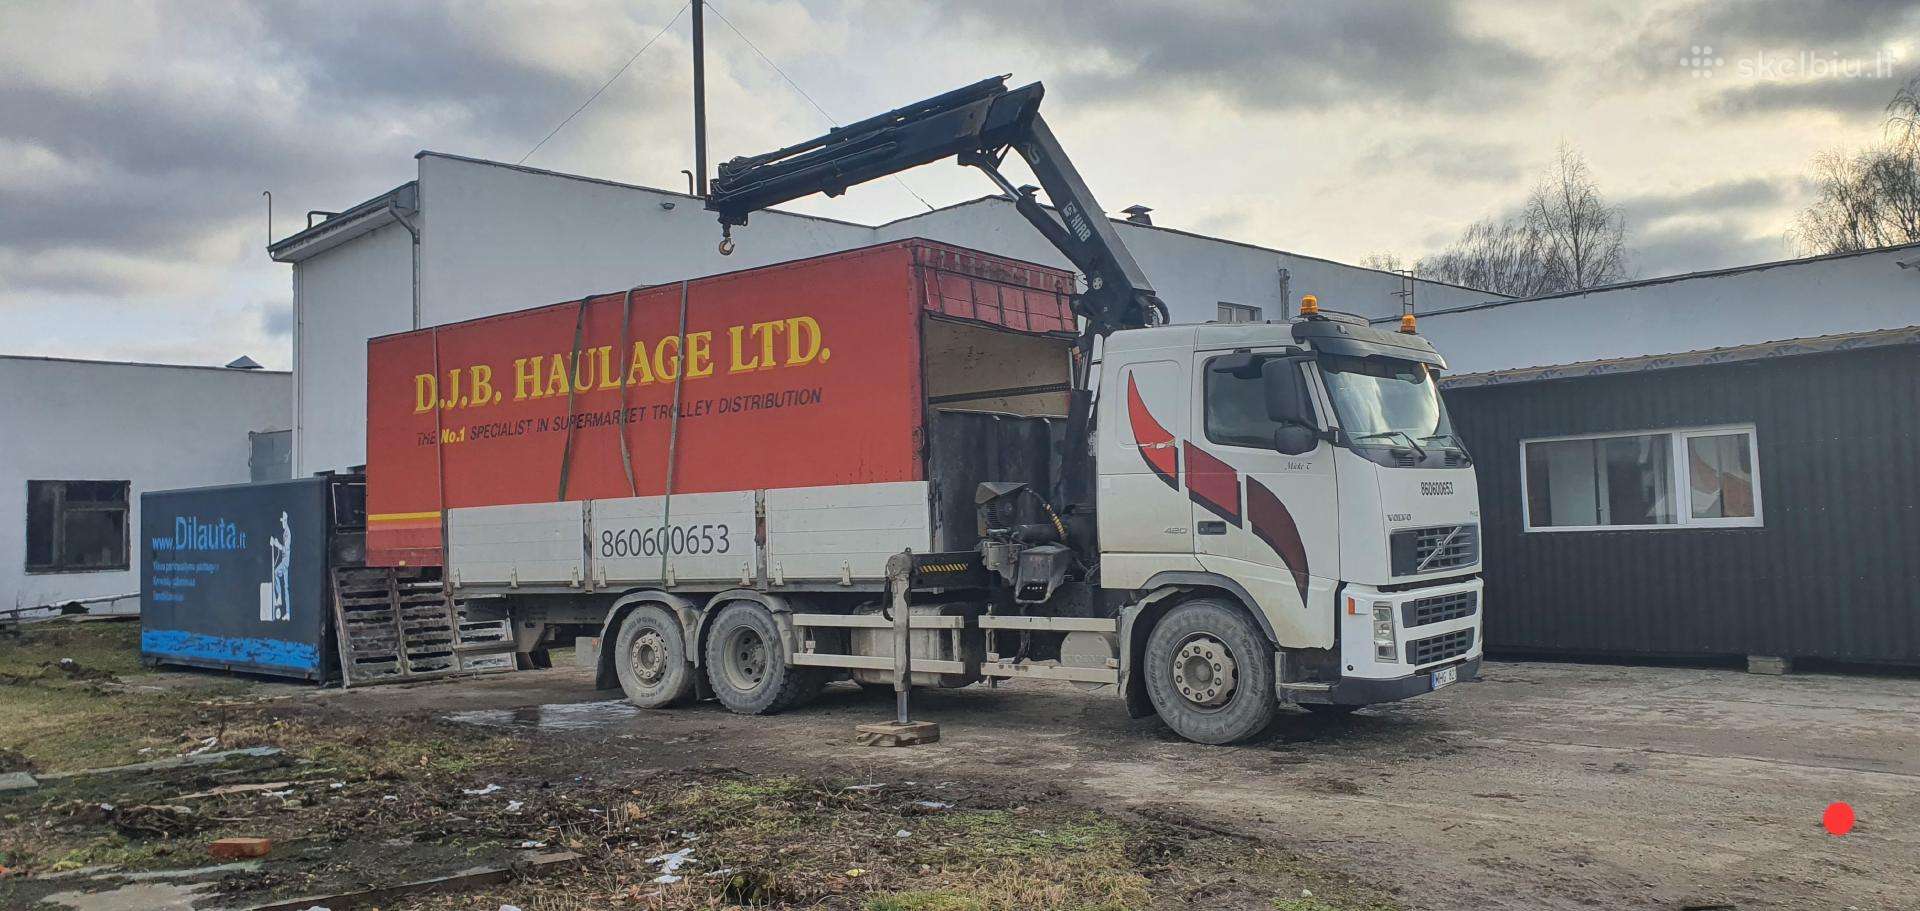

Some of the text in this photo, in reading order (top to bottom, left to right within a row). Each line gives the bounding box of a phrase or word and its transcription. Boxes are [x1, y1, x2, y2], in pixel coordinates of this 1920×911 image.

[414, 315, 831, 414] D.J.B. HAULAGE LTD.
[417, 431, 436, 446] THE
[440, 426, 466, 444] No.1
[470, 419, 533, 440] SPECIALIST
[537, 417, 549, 432] IN
[718, 388, 822, 415] DISTRIBUTION
[1420, 481, 1454, 496] 860600653
[152, 515, 247, 551] www.Dilauta.lt
[1387, 513, 1412, 521] VOLVO
[601, 523, 730, 557] 860600653
